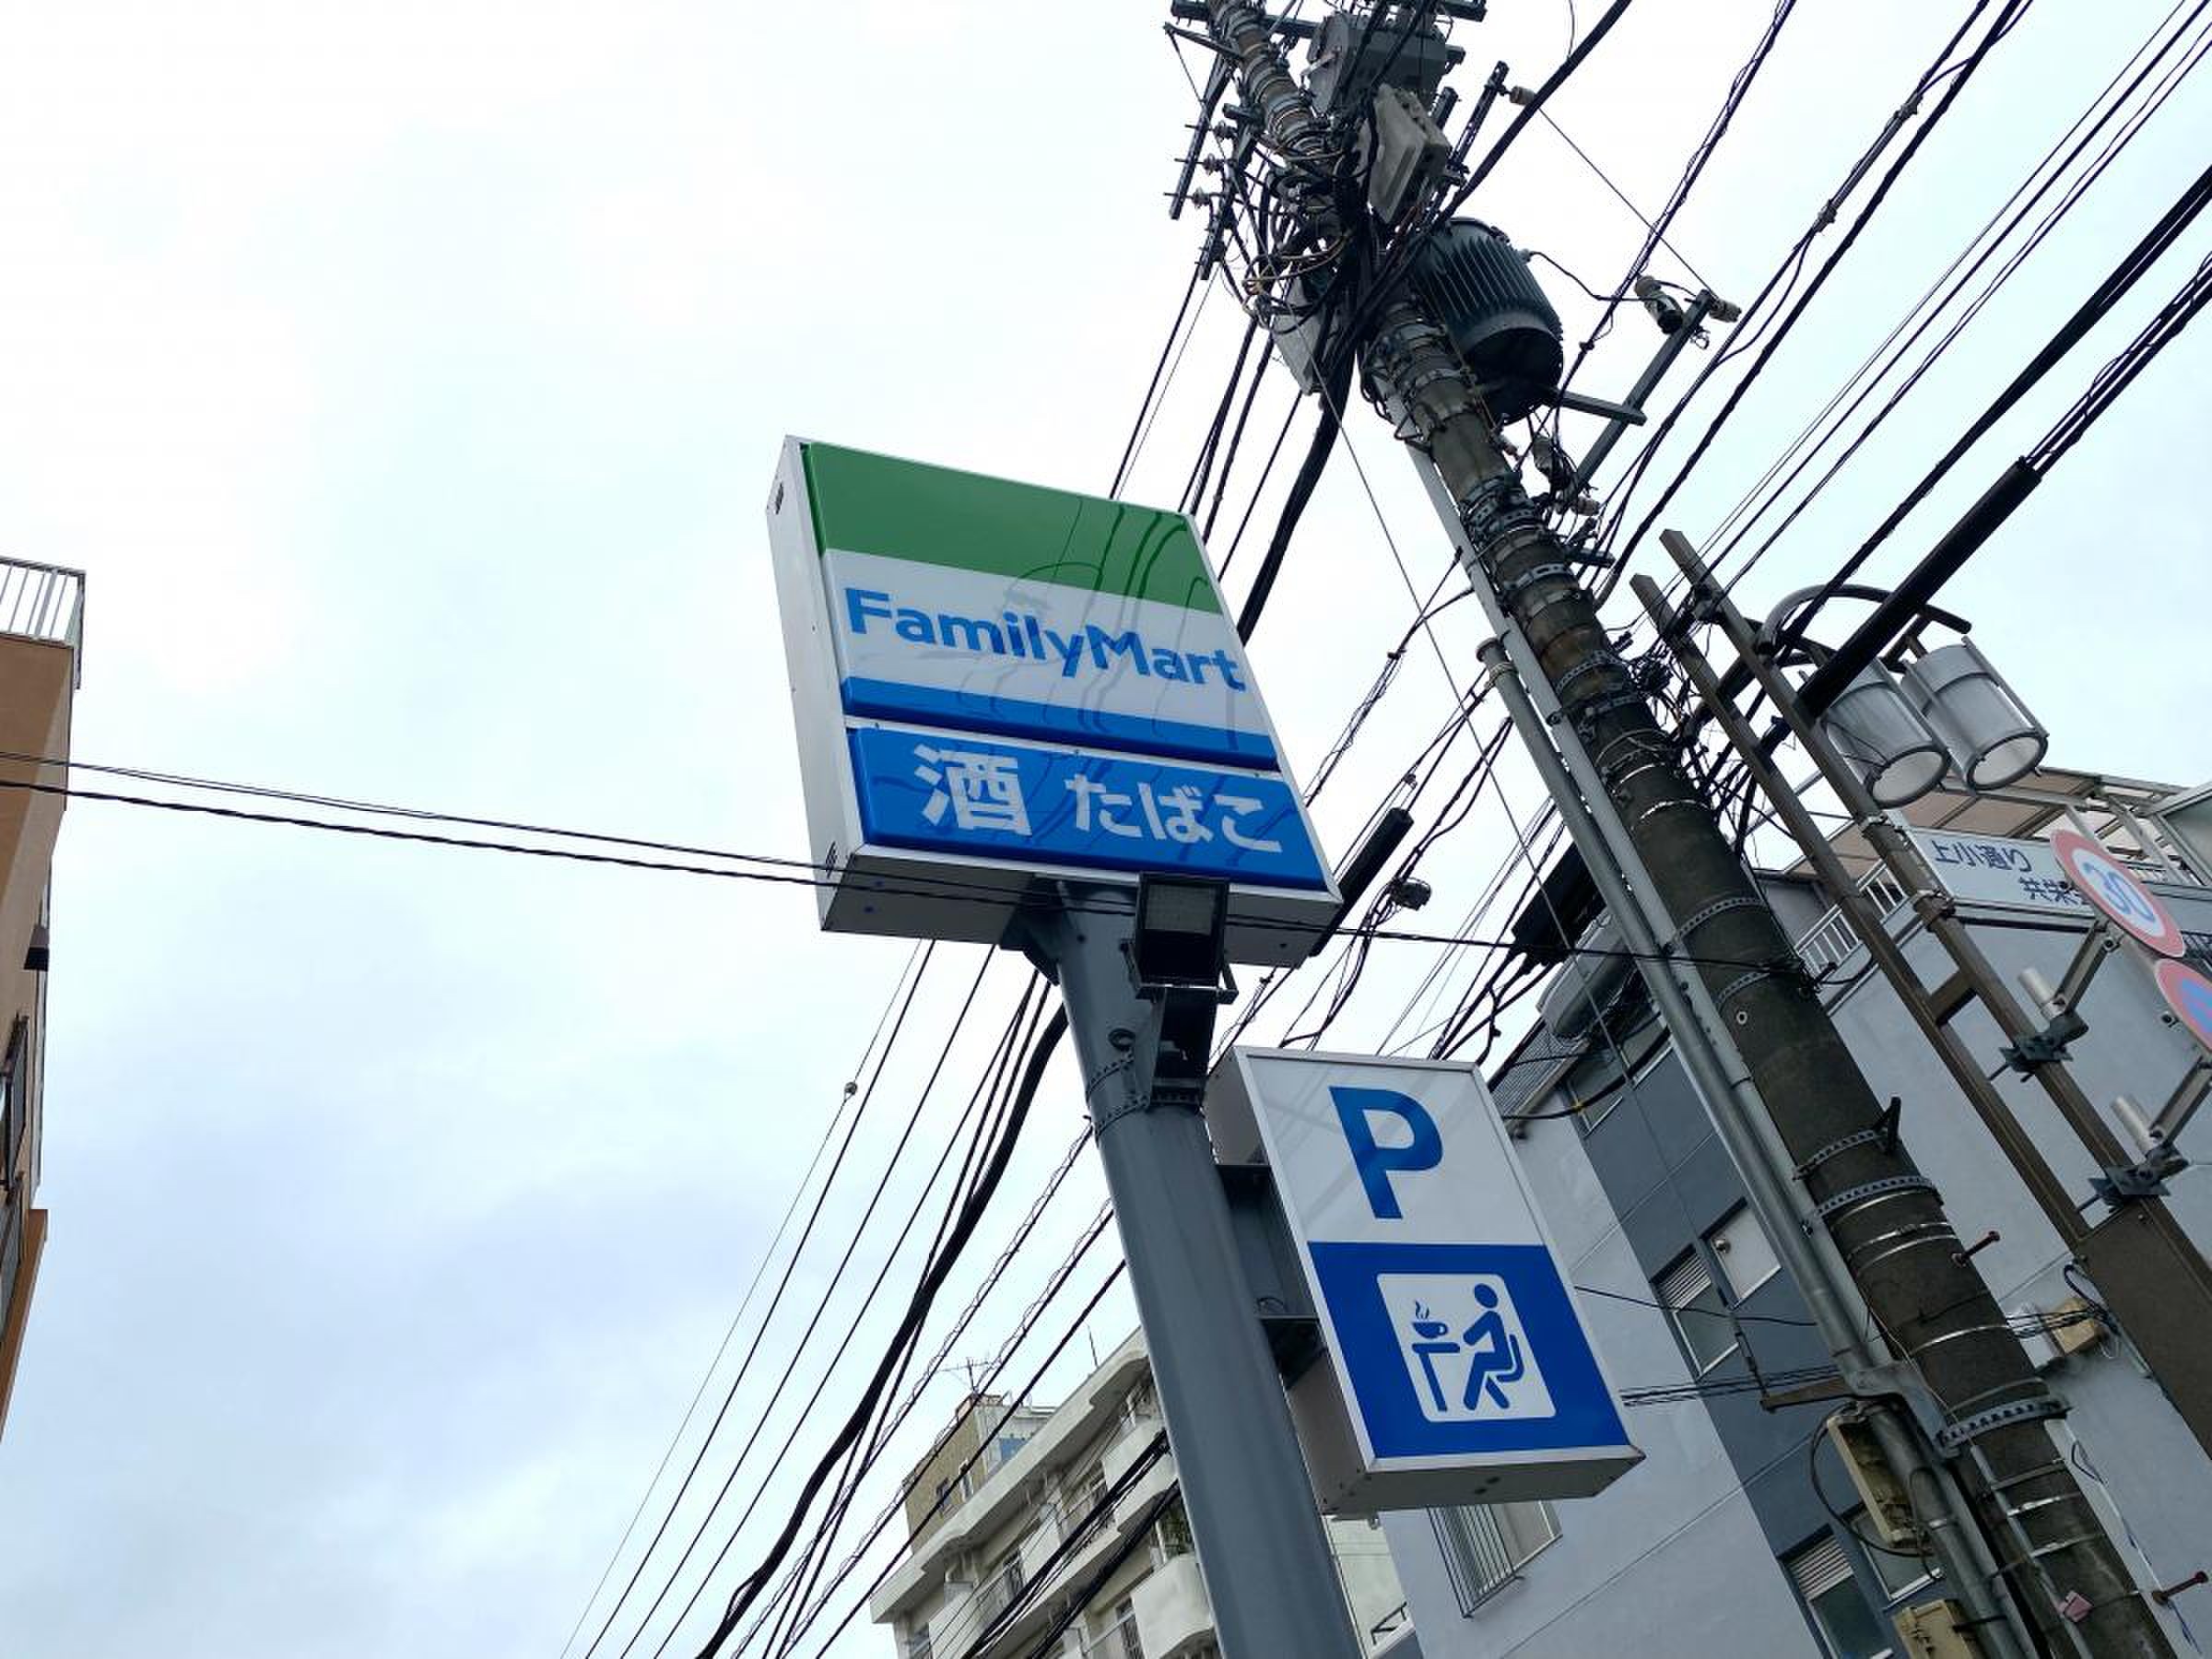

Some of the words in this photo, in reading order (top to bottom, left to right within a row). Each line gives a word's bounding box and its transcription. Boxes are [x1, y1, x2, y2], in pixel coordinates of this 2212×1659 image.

[843, 586, 1246, 691] FamilyMart
[912, 743, 1032, 836] 酒
[1065, 773, 1283, 853] たばこ
[2082, 861, 2157, 923] 30
[1329, 1086, 1443, 1218] P
